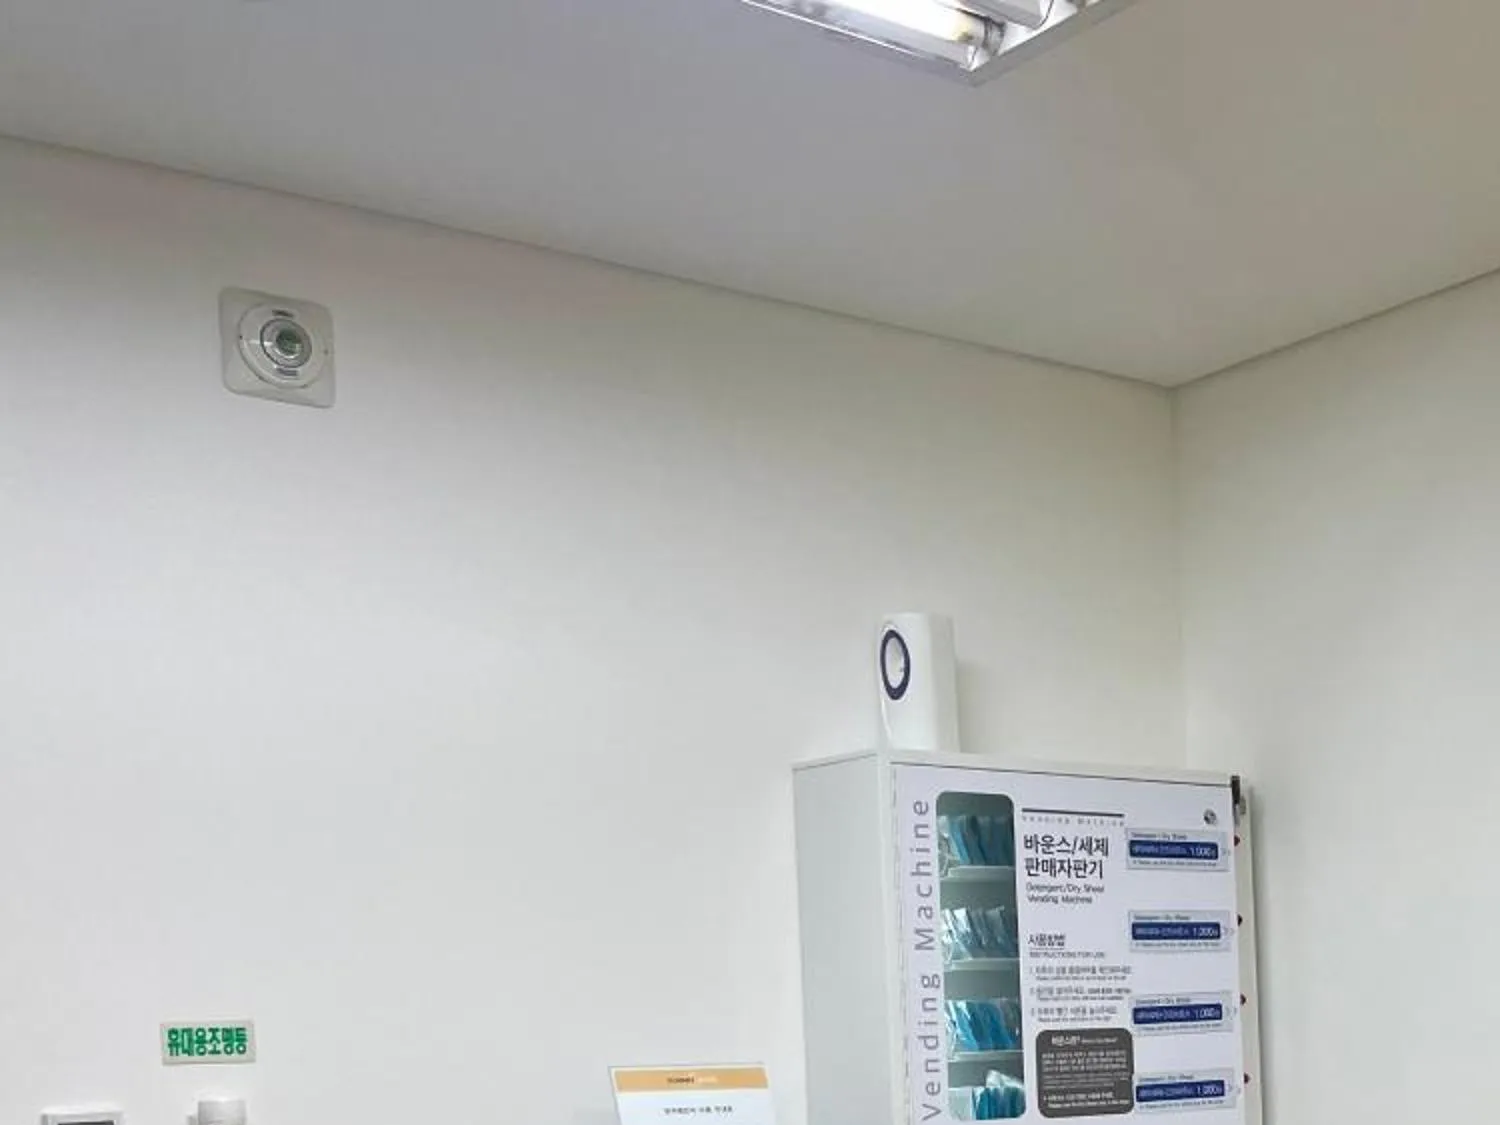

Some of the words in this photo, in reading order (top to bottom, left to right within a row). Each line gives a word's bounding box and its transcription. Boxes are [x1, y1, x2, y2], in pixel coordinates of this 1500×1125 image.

[1024, 834, 1109, 857] 바운스/세제
[910, 800, 934, 951] Machine
[1024, 857, 1103, 879] 판매자판기
[168, 1027, 247, 1057] 휴대용조명등
[918, 973, 941, 1121] Vending
